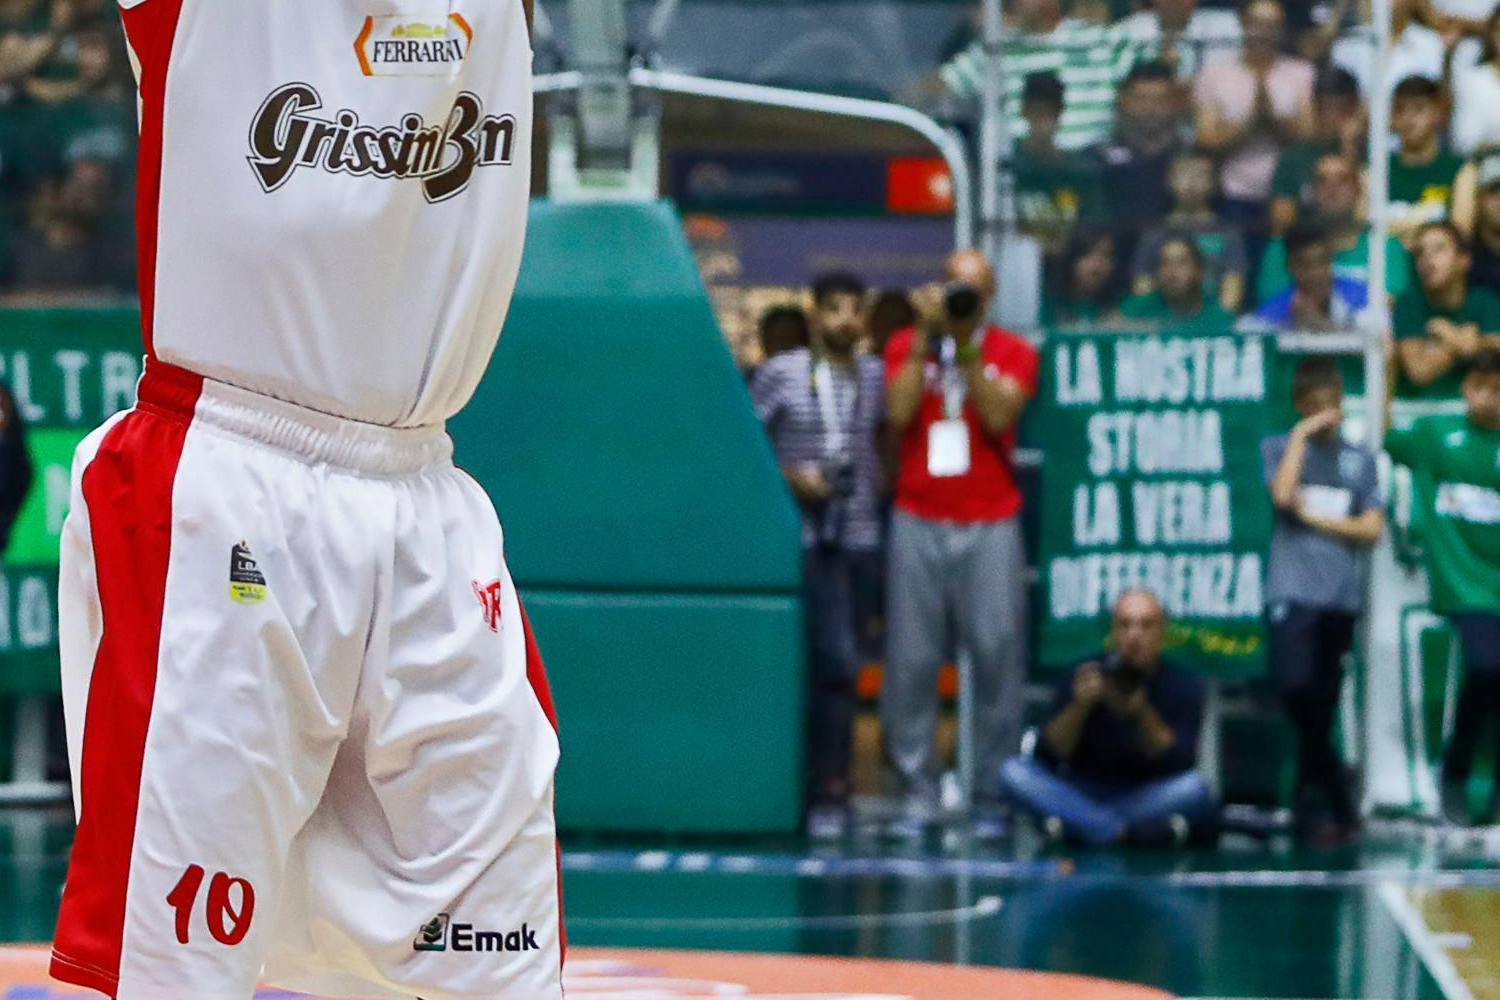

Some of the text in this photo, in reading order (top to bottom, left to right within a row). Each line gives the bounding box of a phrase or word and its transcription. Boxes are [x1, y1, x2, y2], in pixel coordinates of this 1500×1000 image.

[1056, 336, 1266, 403] LA NOSTRA
[1088, 410, 1223, 475] STORIA
[1073, 480, 1232, 545] LA VERA
[166, 864, 255, 945] 10
[451, 921, 540, 952] Emak
